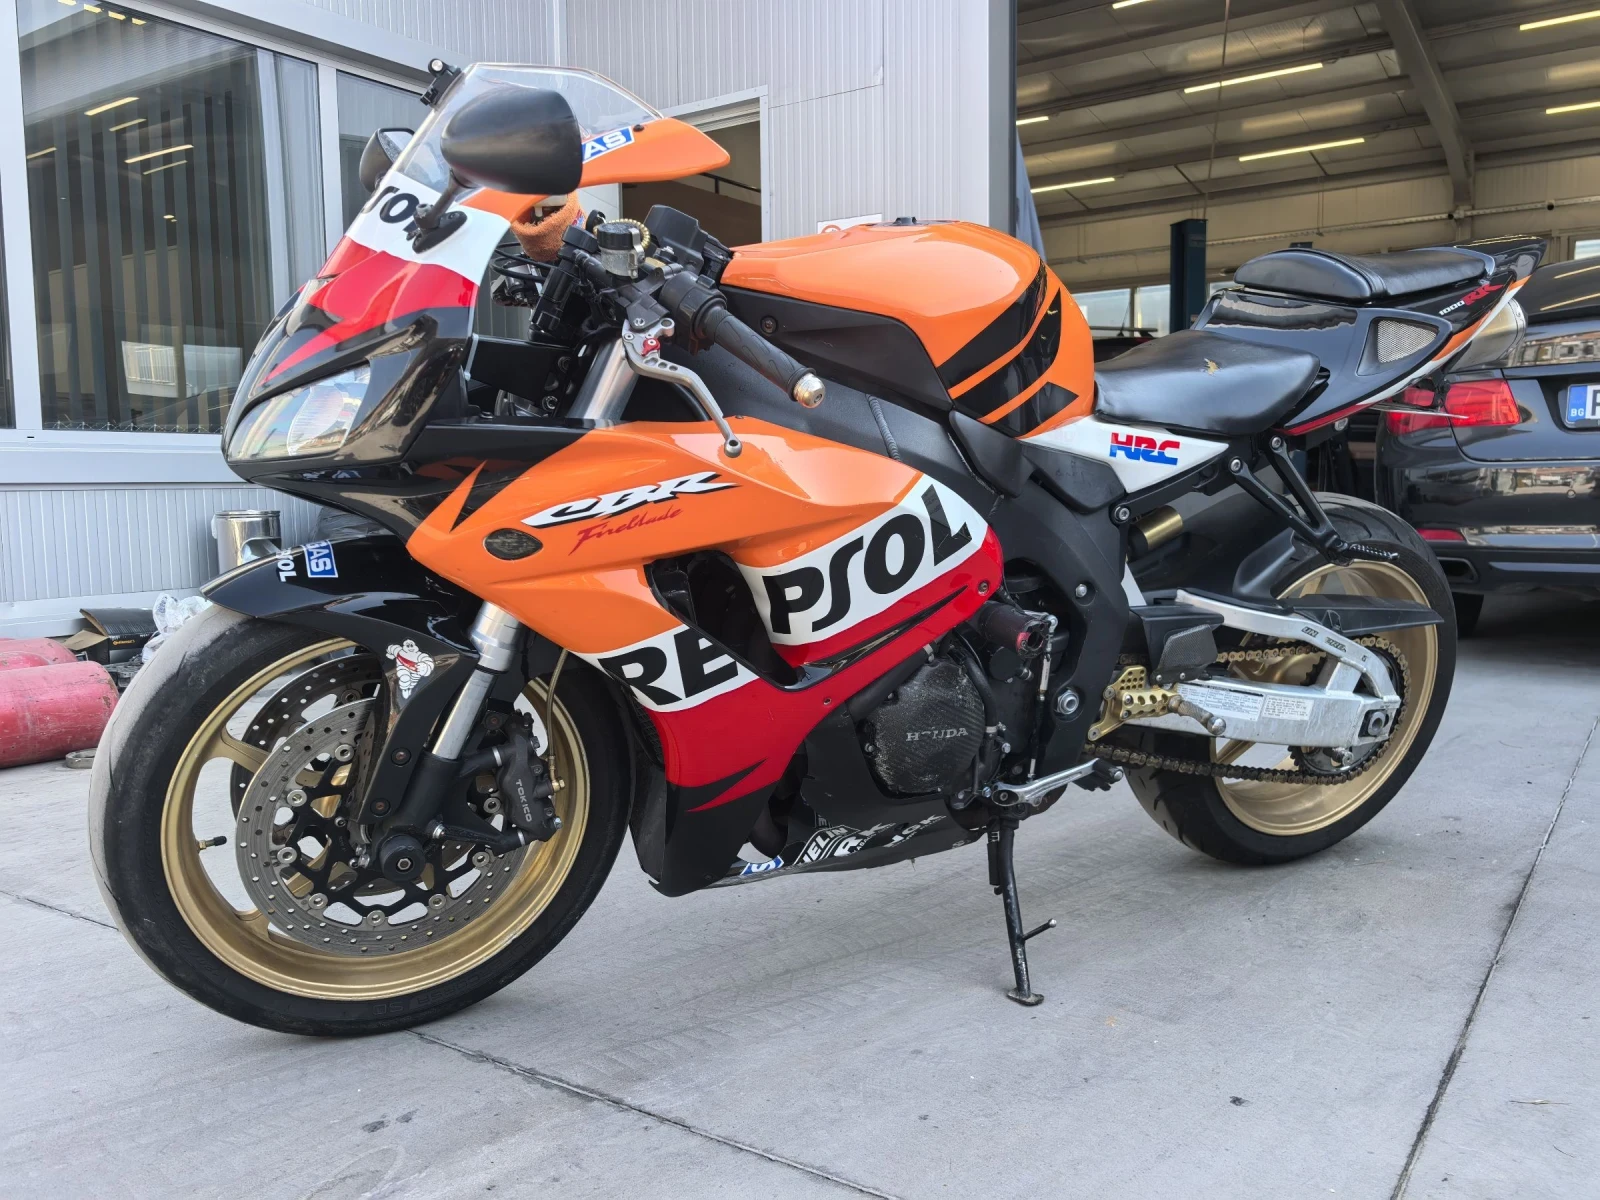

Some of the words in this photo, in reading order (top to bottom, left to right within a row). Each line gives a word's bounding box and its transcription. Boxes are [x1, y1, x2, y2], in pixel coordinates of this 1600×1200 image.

[1570, 408, 1584, 417] BG
[1109, 432, 1180, 466] HRC
[520, 471, 743, 528] CBR
[568, 504, 683, 556] Fireblade
[515, 779, 532, 822] TOKICO
